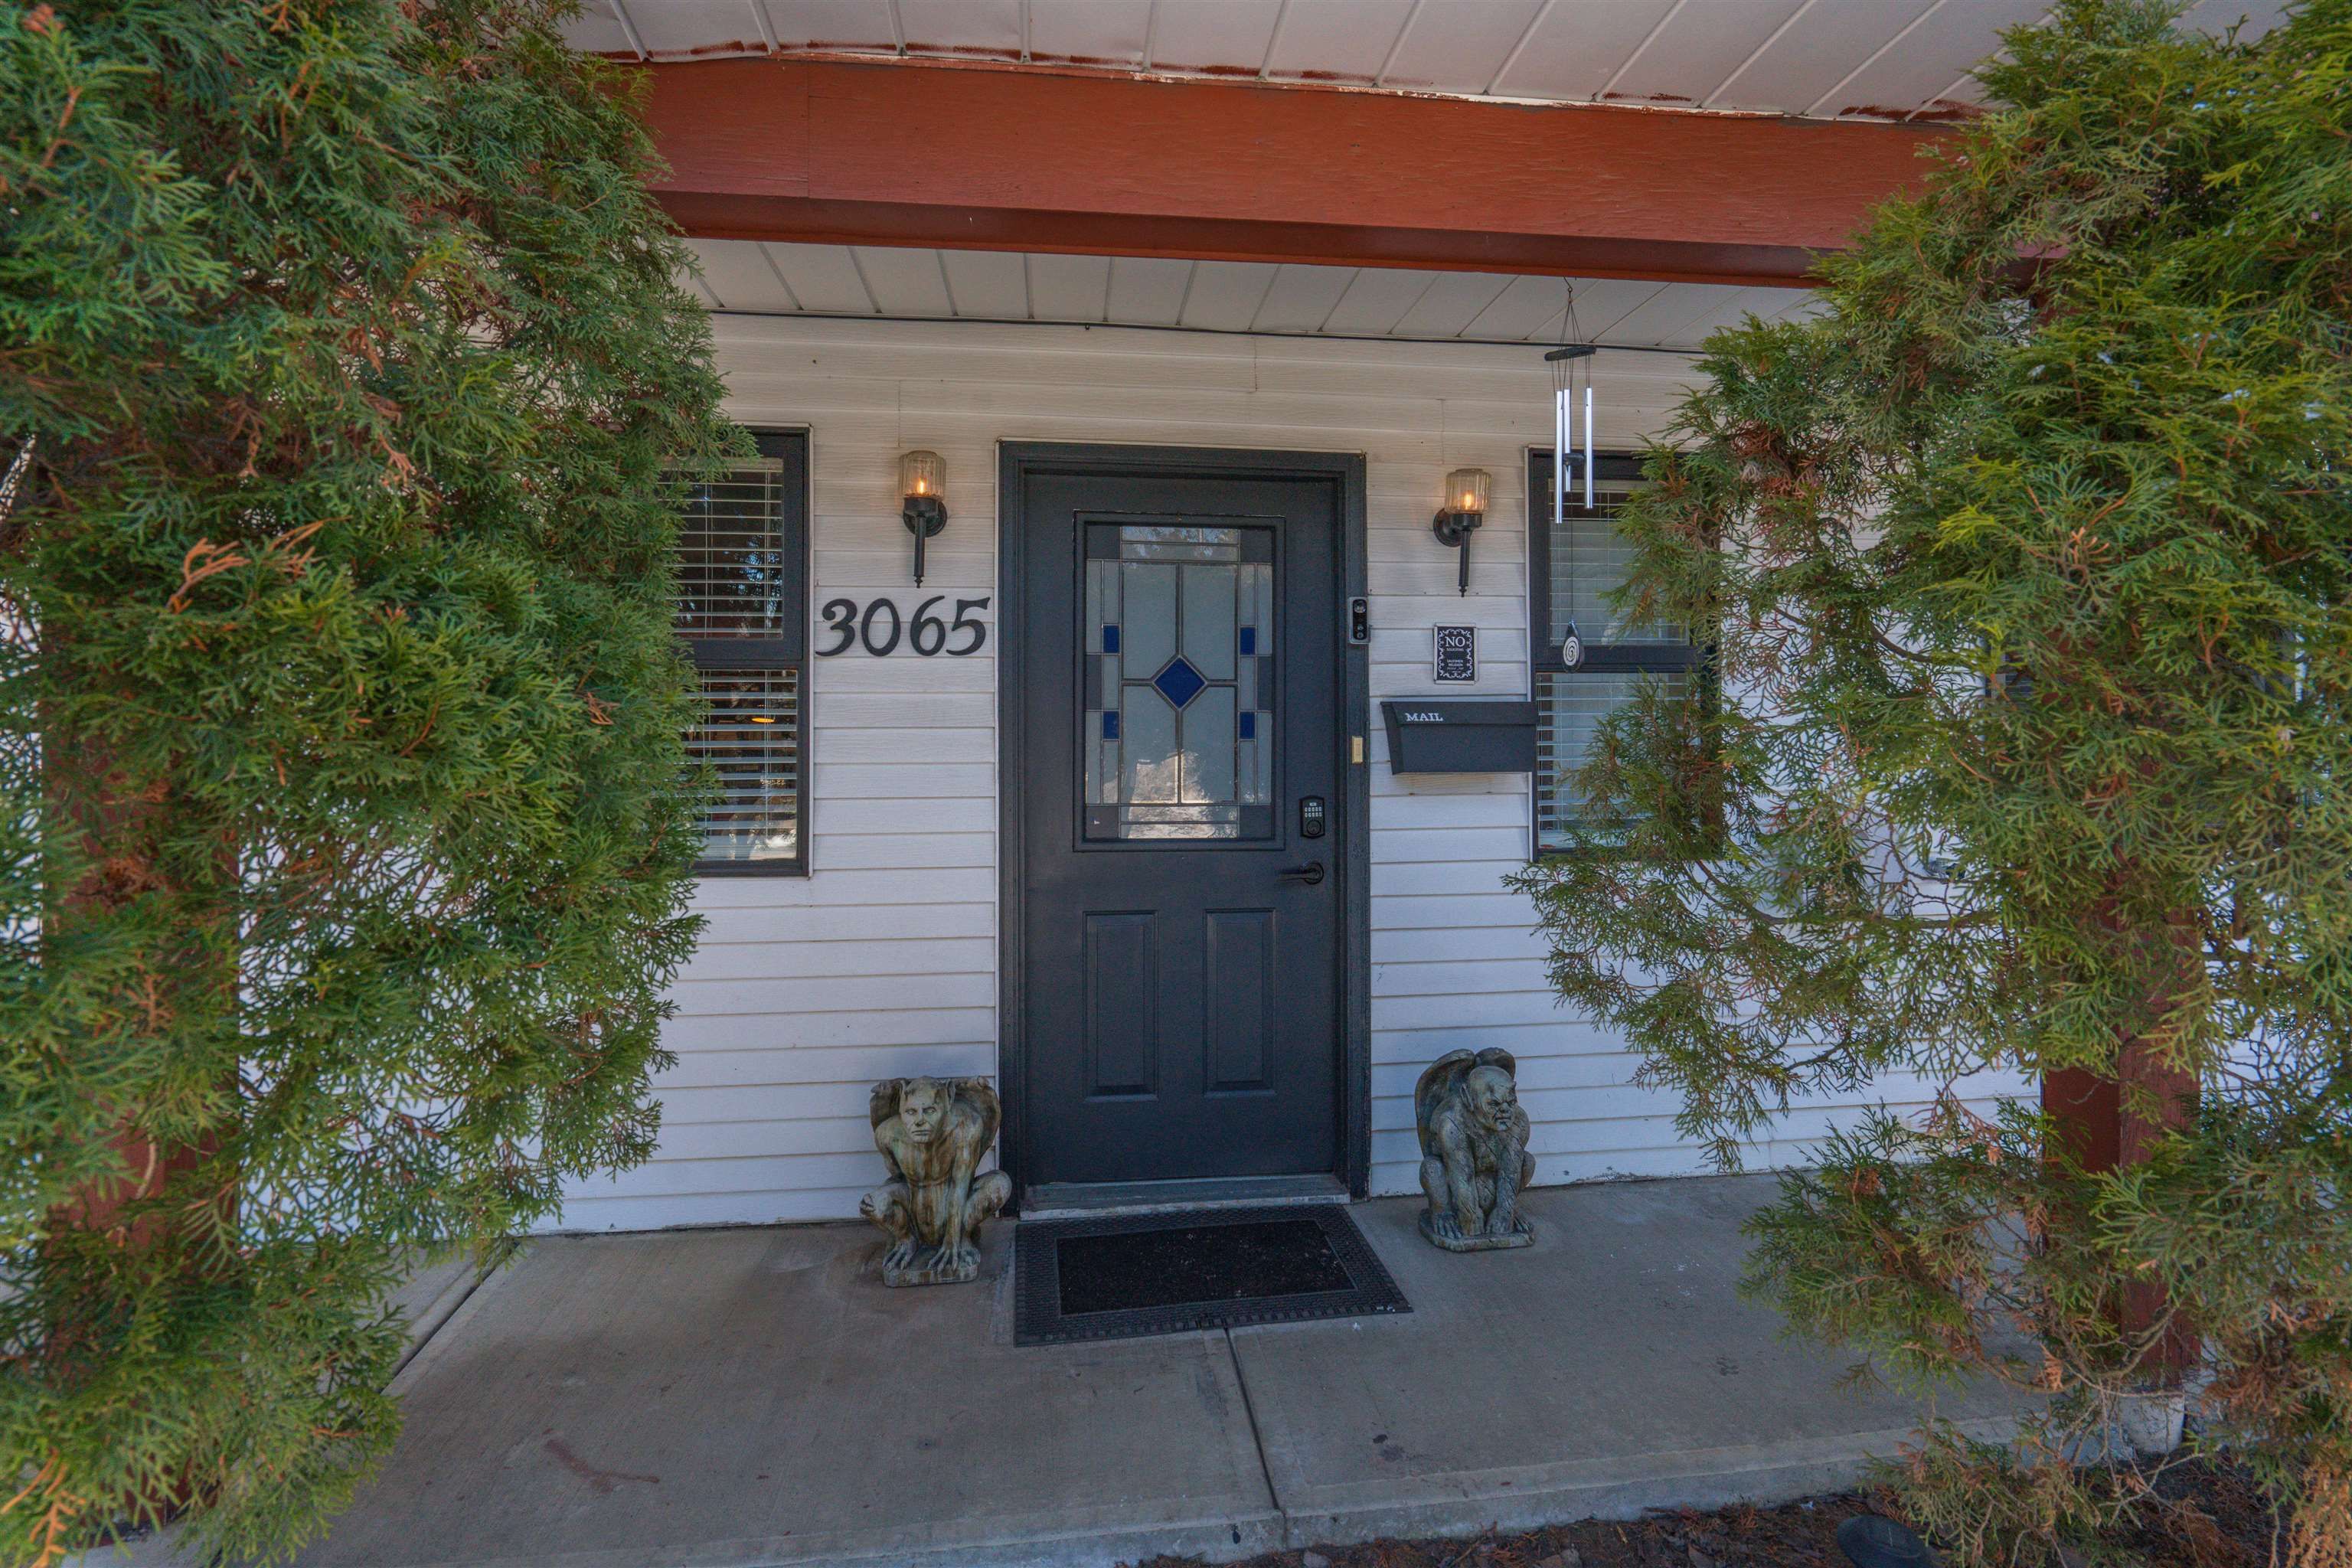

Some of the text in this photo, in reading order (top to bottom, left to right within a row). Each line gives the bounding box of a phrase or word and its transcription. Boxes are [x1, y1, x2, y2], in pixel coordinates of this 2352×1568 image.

[815, 595, 991, 657] 3065
[1445, 636, 1465, 647] NO
[1405, 713, 1443, 721] MAIL
